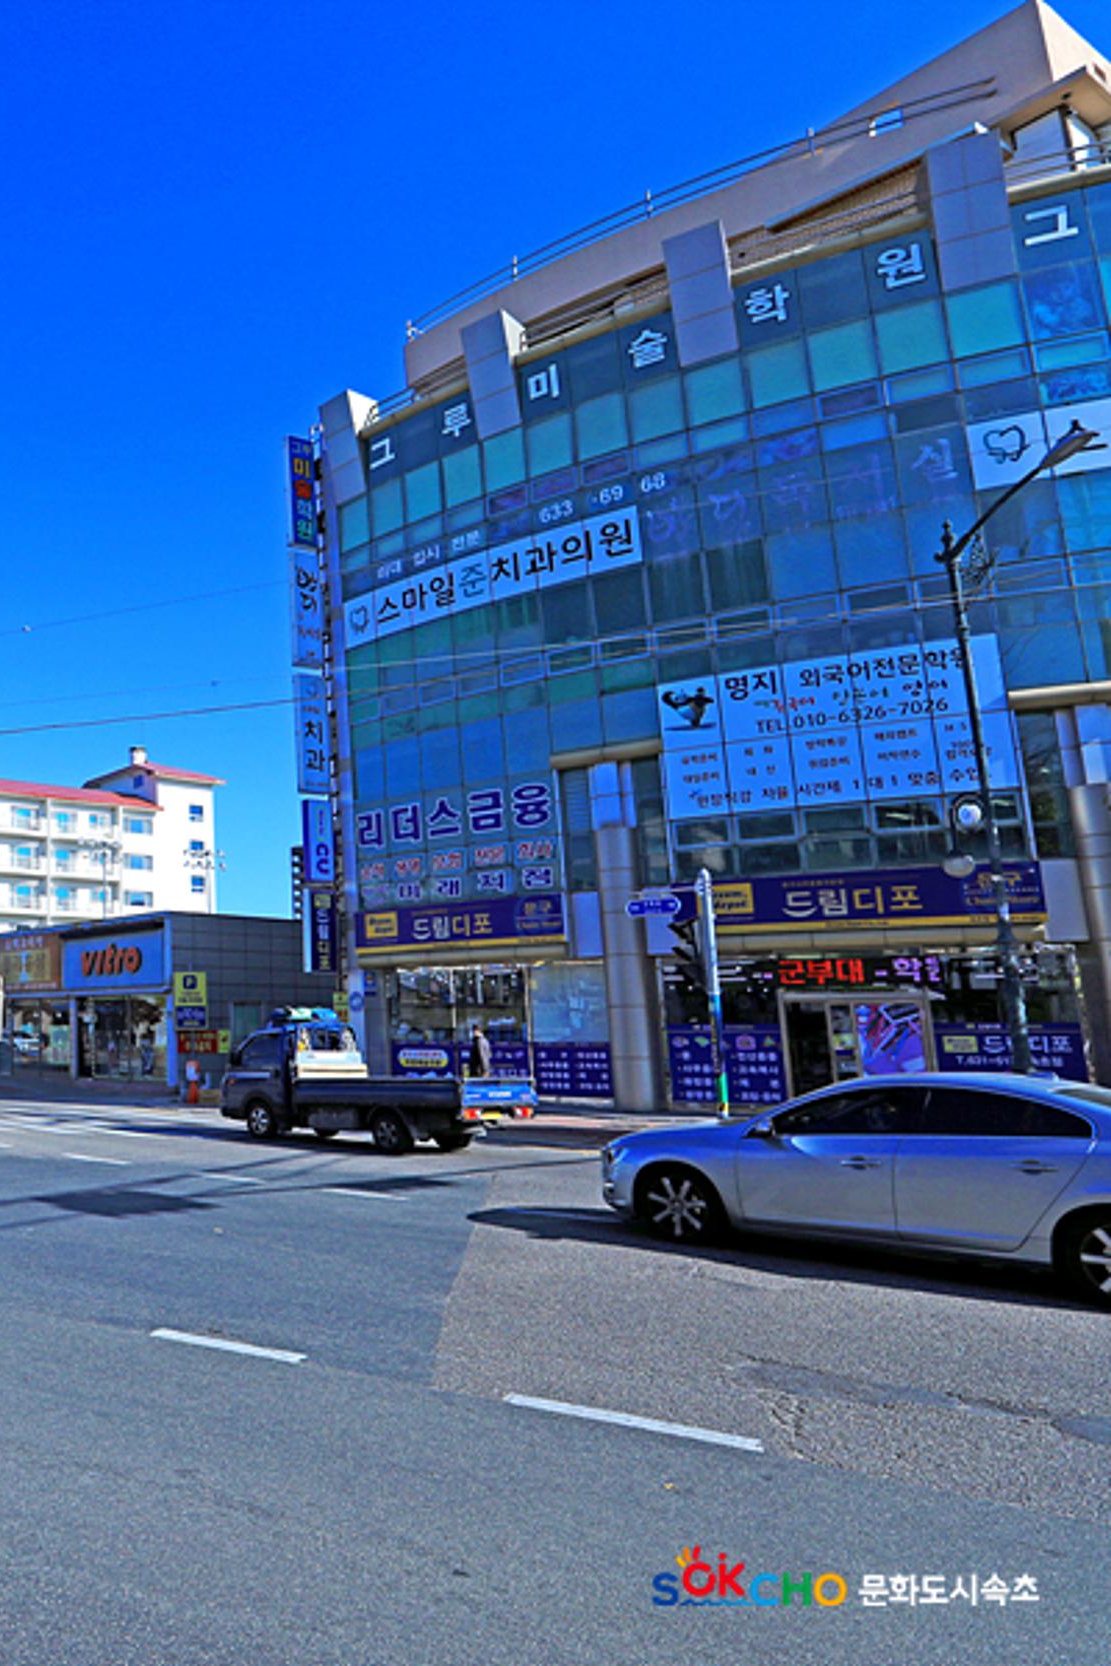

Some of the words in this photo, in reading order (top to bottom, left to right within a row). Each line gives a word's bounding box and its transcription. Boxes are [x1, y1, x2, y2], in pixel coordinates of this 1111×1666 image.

[724, 670, 778, 701] 명지
[356, 783, 551, 848] 리더스금융
[781, 882, 926, 918] 드림디포
[412, 912, 493, 940] 드림디포
[777, 957, 866, 986] 군부대
